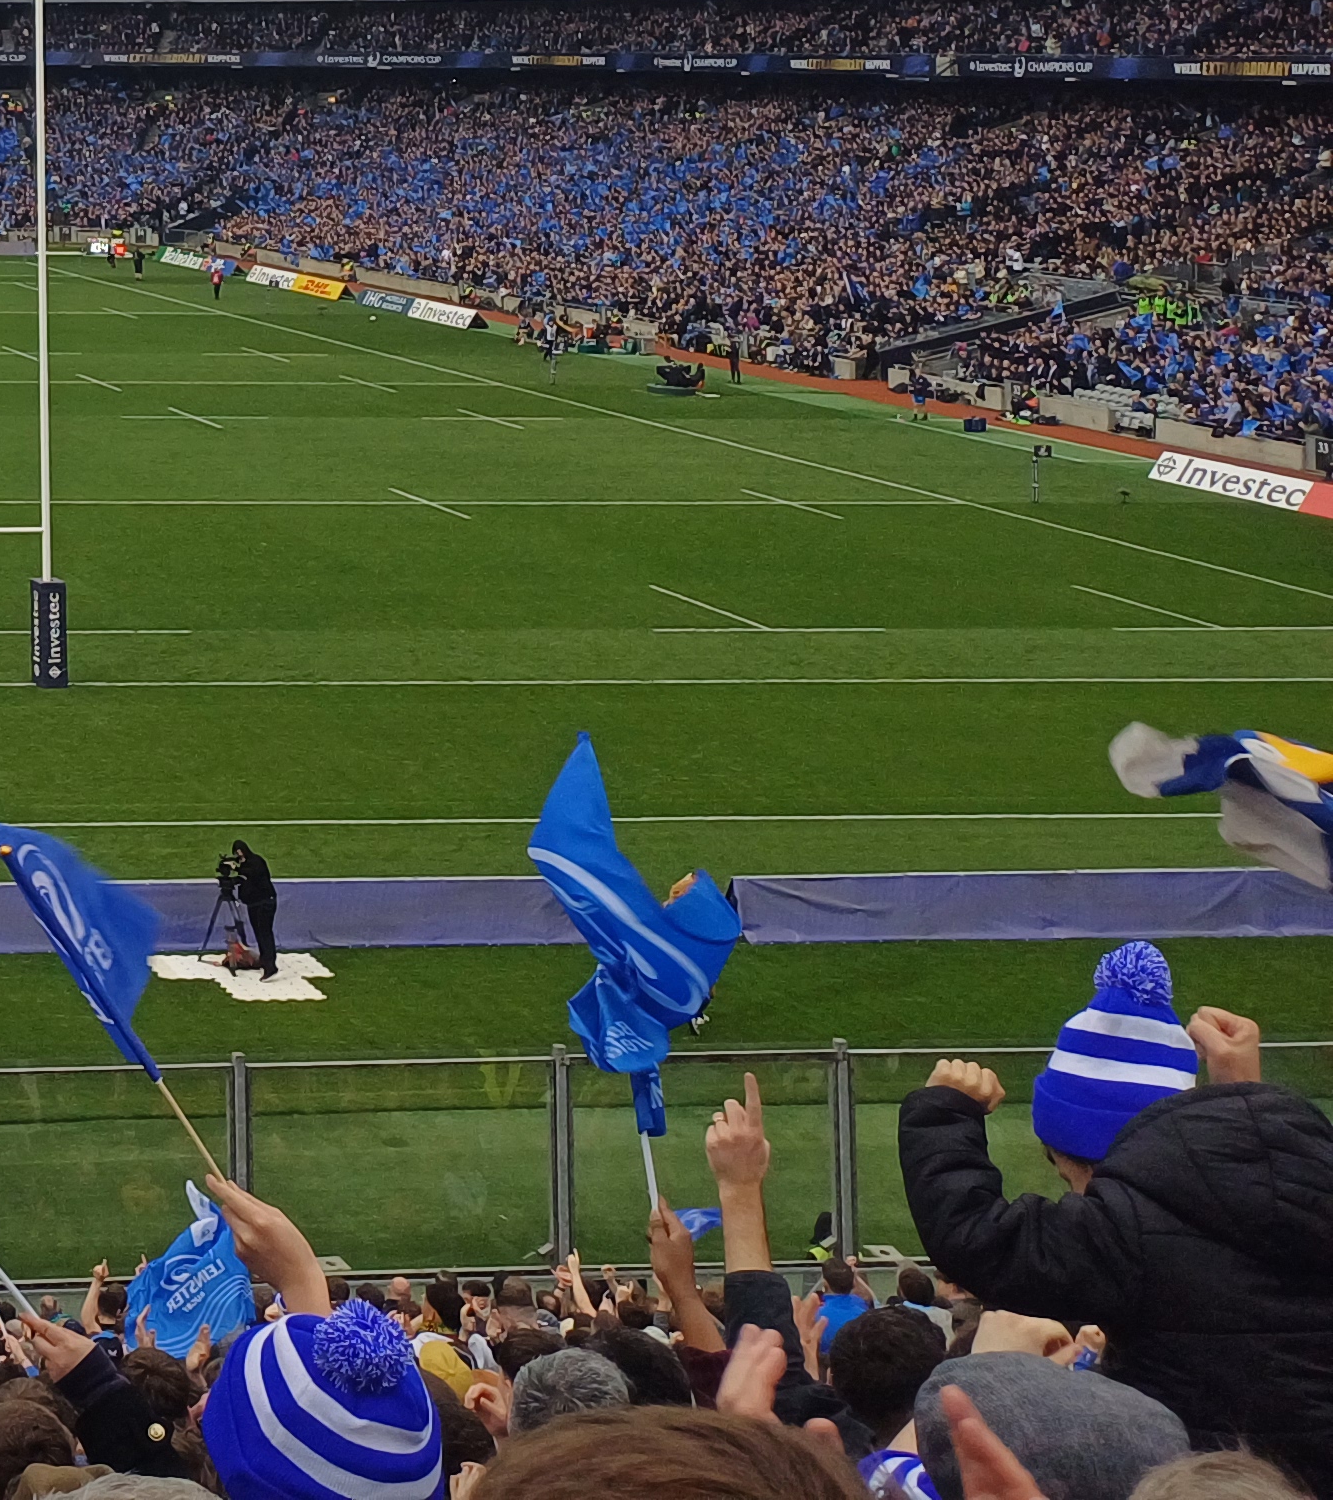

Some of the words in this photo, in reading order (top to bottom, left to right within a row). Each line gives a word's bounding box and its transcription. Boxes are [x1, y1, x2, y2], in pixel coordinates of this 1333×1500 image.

[975, 61, 1013, 72] Investec
[1027, 61, 1074, 72] CHAMPIONS
[1075, 61, 1093, 73] CUP
[1174, 63, 1202, 74] WHERE
[1202, 61, 1292, 76] EXTRAORDINARY
[1292, 63, 1331, 75] HAPPENS
[255, 266, 294, 289] Investec
[304, 279, 332, 296] DHL
[362, 290, 386, 308] IHG
[419, 301, 472, 327] Investec
[1176, 458, 1307, 506] Investec
[48, 592, 62, 664] Investec
